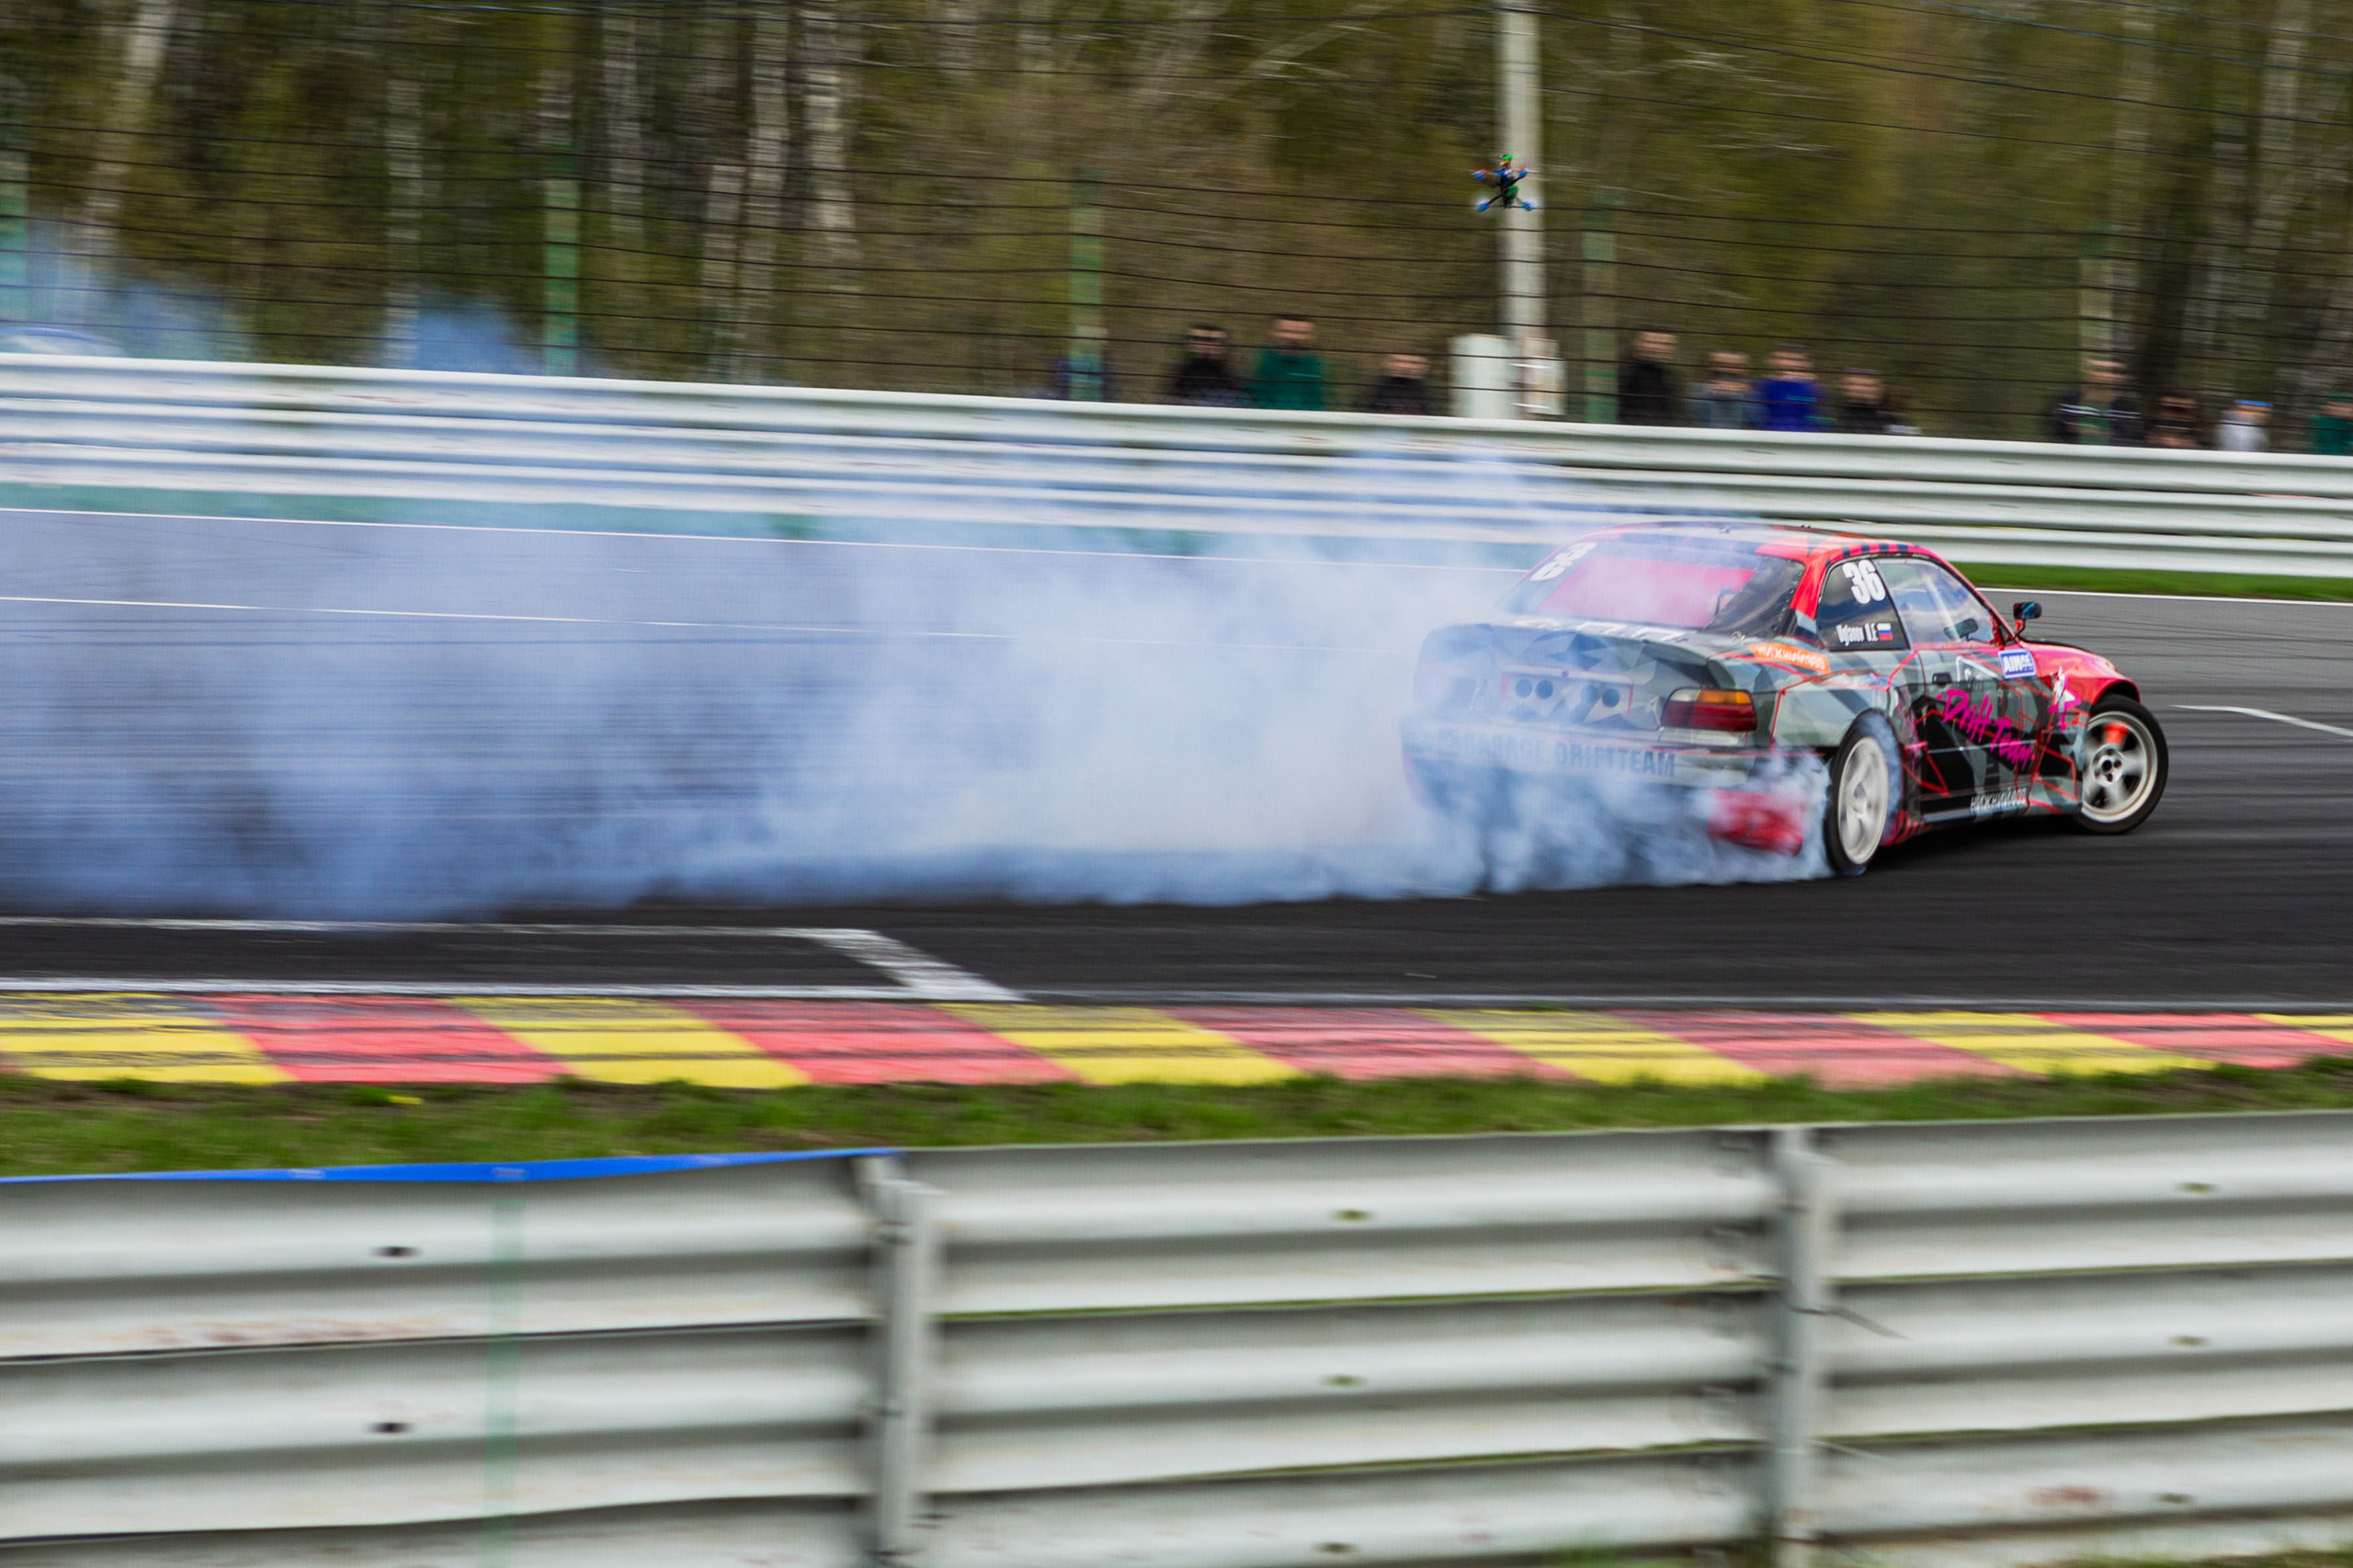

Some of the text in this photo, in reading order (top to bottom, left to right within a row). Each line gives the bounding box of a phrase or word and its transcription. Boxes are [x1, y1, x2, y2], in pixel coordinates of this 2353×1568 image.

[1842, 559, 1886, 604] 36
[1938, 688, 2036, 766] Drift Team
